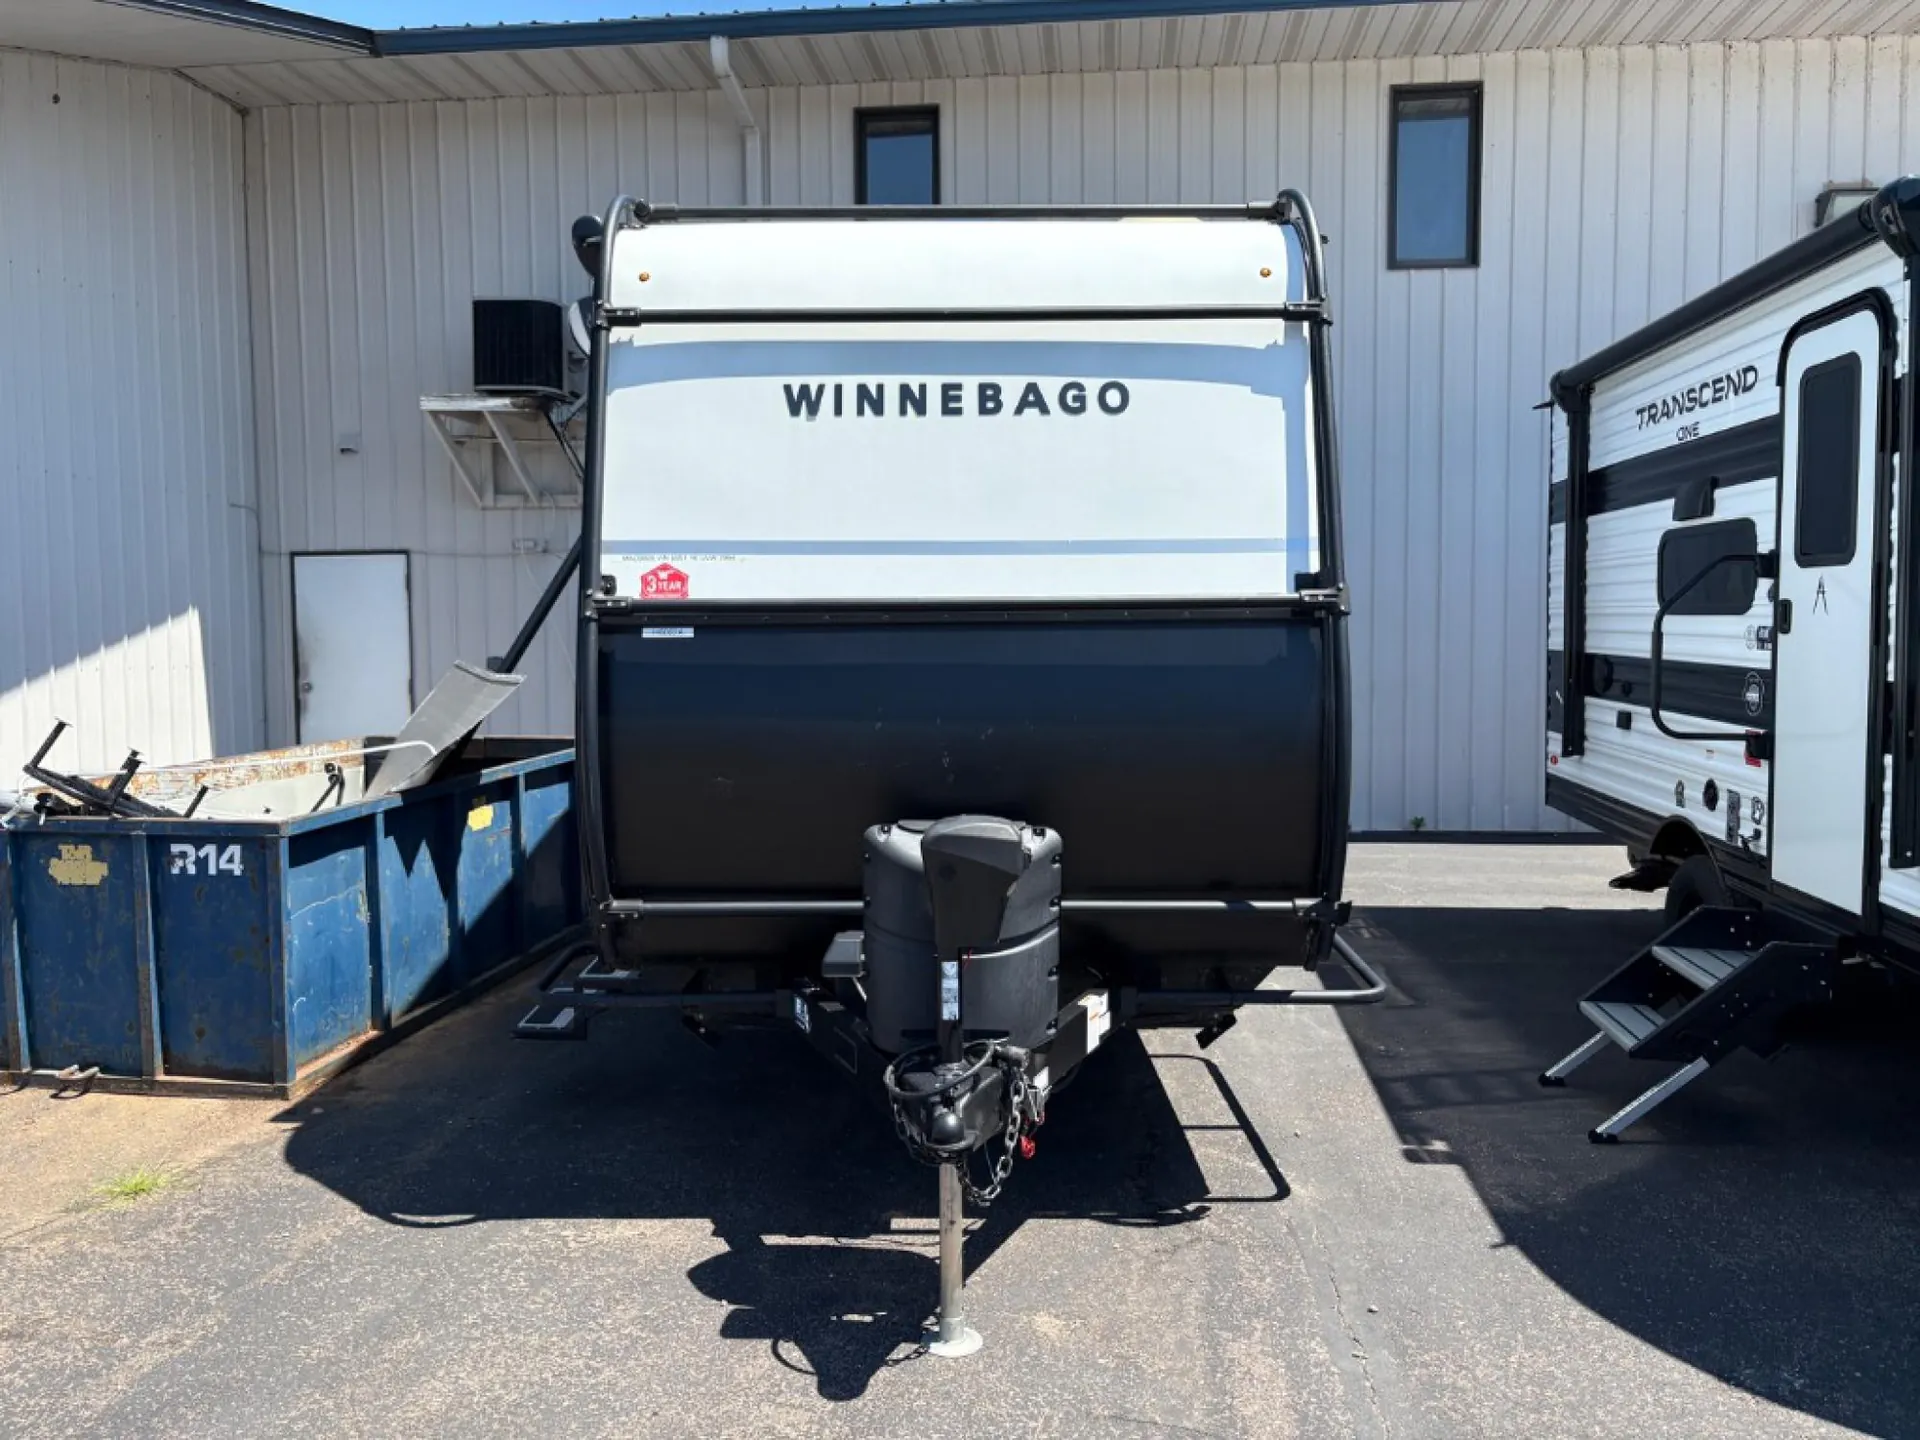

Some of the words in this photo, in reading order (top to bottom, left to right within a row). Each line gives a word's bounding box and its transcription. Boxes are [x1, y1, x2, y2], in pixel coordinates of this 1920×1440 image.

[783, 381, 1130, 417] WINNEBAGO
[1636, 365, 1758, 430] TRANSCEND
[1676, 421, 1700, 441] ONE
[646, 575, 658, 593] 3
[657, 580, 683, 592] YEAR
[169, 843, 243, 876] R14
